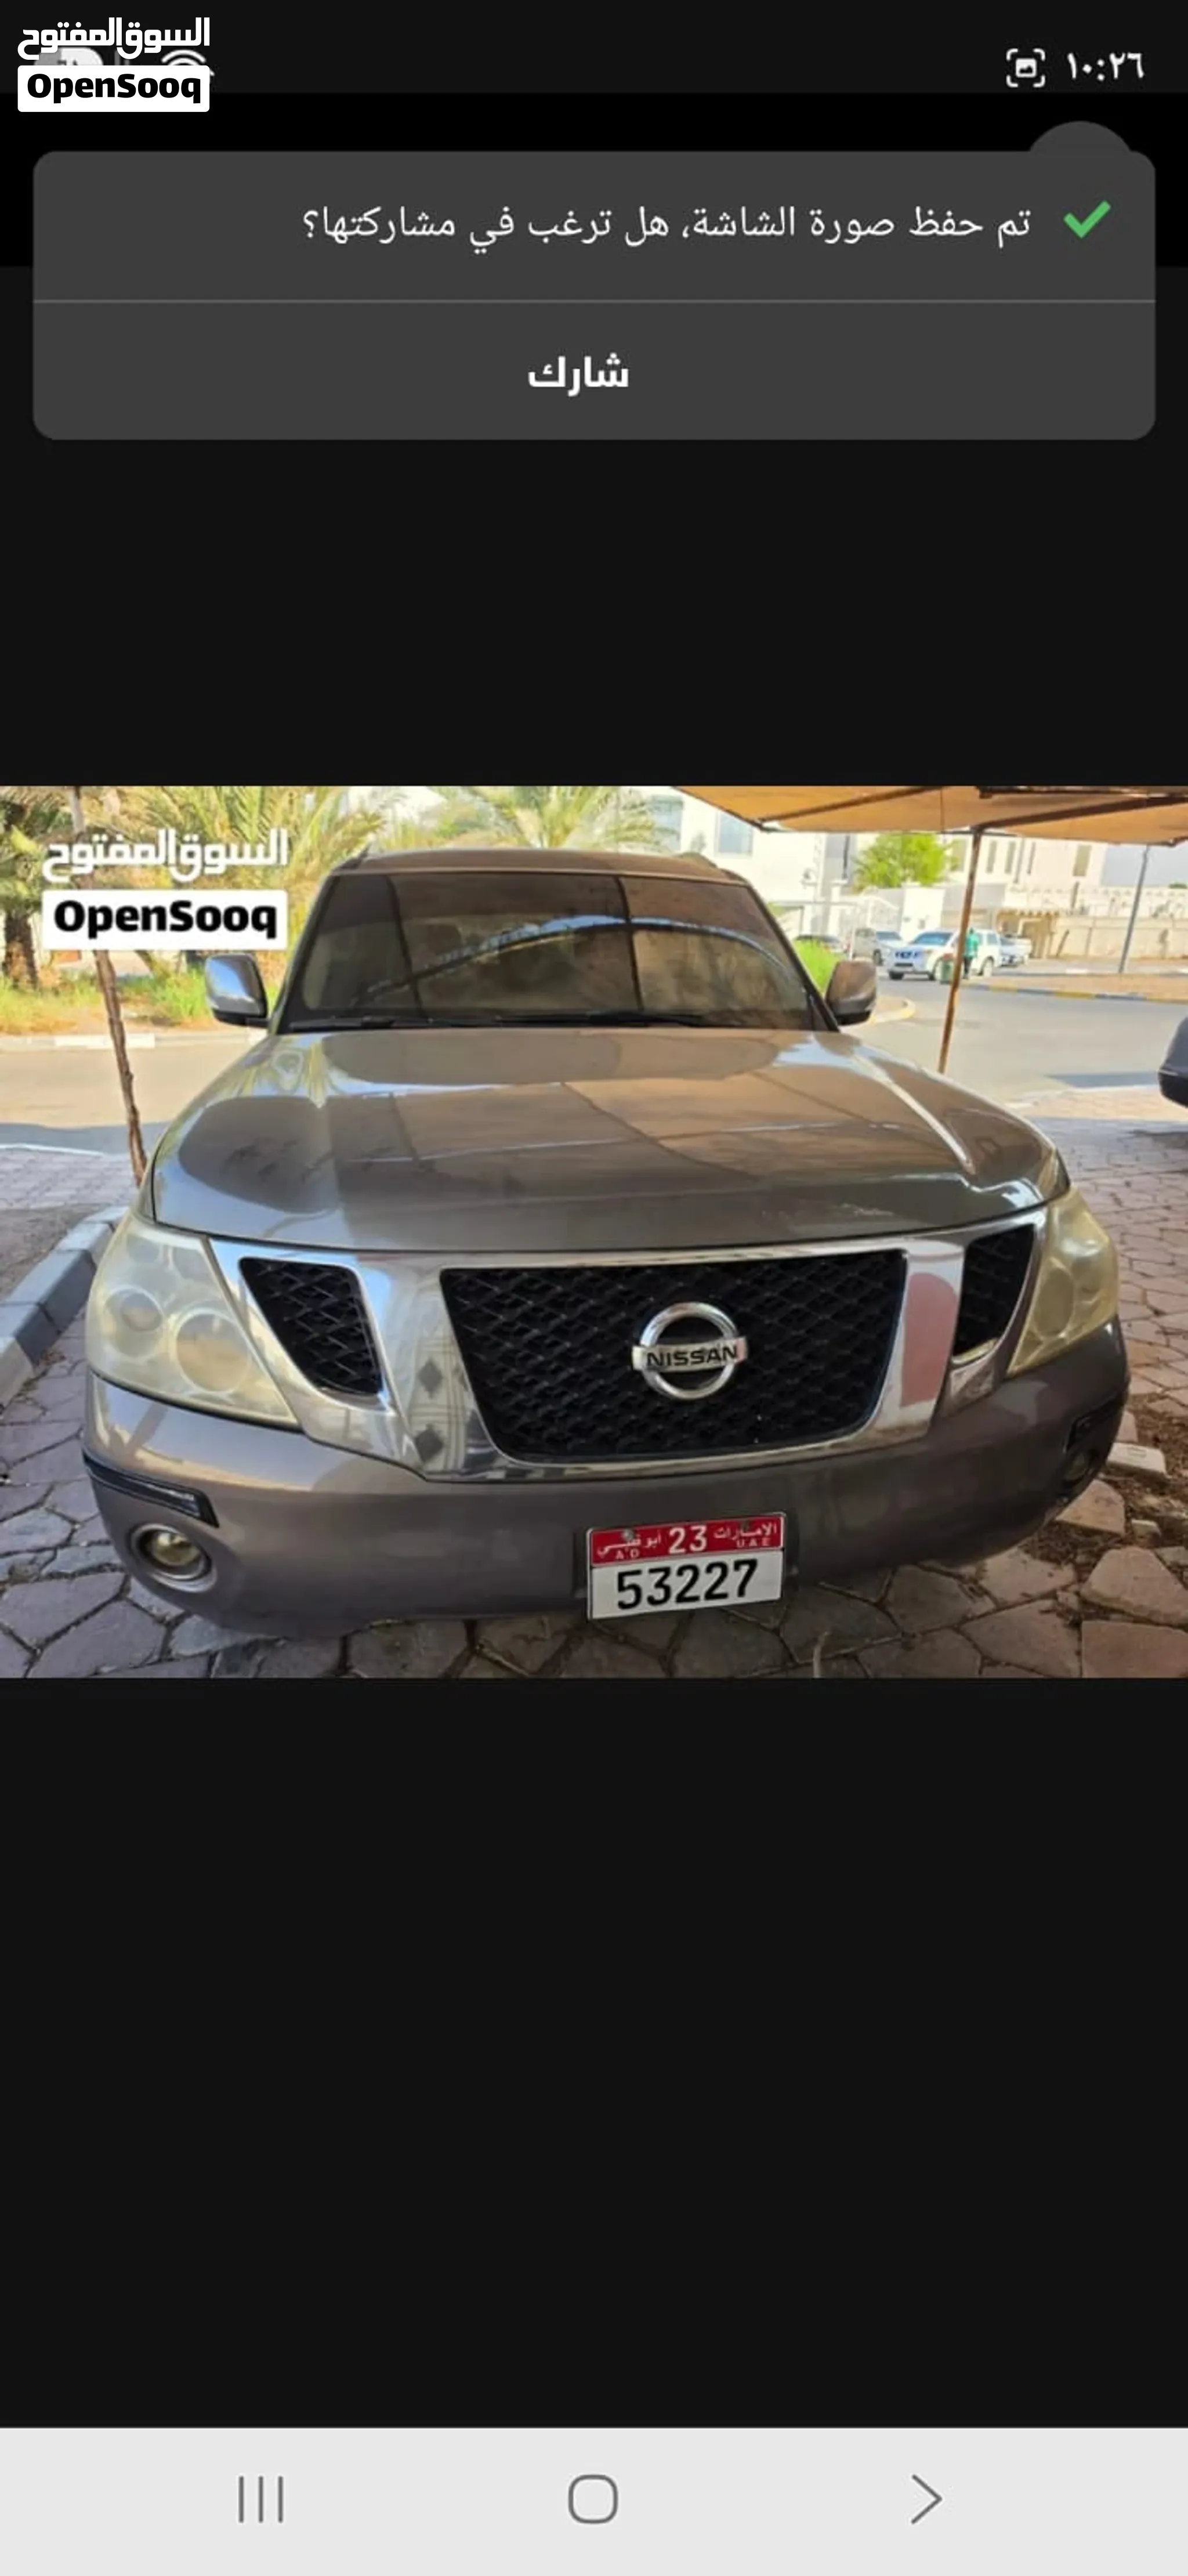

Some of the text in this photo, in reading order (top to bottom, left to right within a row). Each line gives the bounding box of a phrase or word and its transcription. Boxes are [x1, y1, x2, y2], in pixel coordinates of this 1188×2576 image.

[1067, 52, 1144, 81] ١٠:٢٦
[470, 206, 515, 255] في
[528, 210, 612, 244] ترغب
[625, 206, 669, 247] هل
[809, 209, 894, 244] صورة
[909, 206, 983, 236] حفظ
[998, 209, 1031, 249] تم
[528, 352, 629, 397] شارك
[647, 1345, 737, 1367] NISSAN
[669, 1525, 707, 1554] 23
[617, 1558, 758, 1610] 53227
